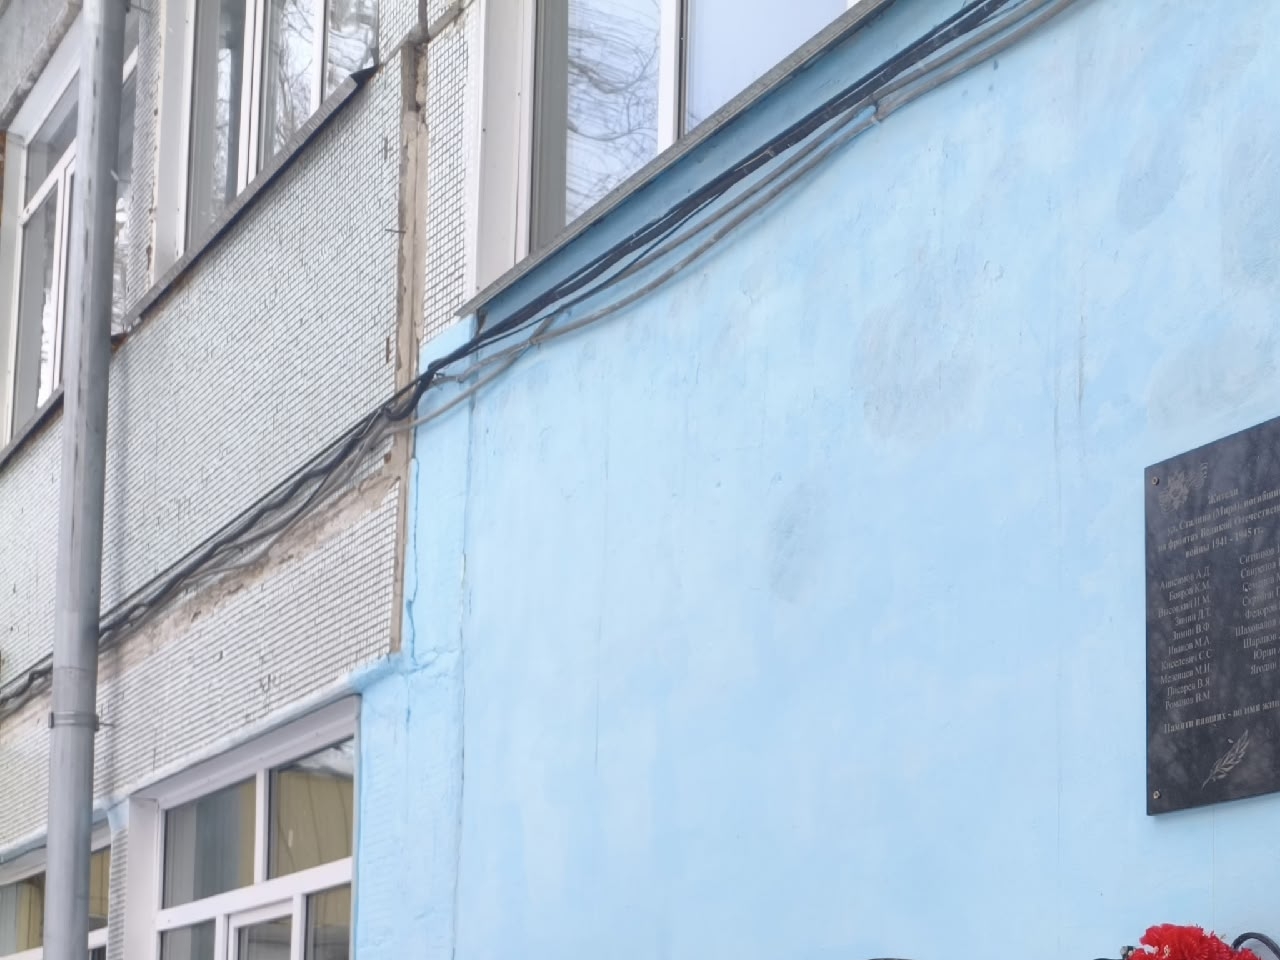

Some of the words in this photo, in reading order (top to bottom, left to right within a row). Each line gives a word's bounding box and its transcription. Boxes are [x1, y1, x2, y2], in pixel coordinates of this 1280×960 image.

[1212, 536, 1227, 549] 1941
[1236, 527, 1252, 542] 1945
[1163, 719, 1194, 734] Памяти
[1195, 712, 1226, 726] павших
[1233, 708, 1243, 718] во
[1243, 703, 1260, 715] имя
